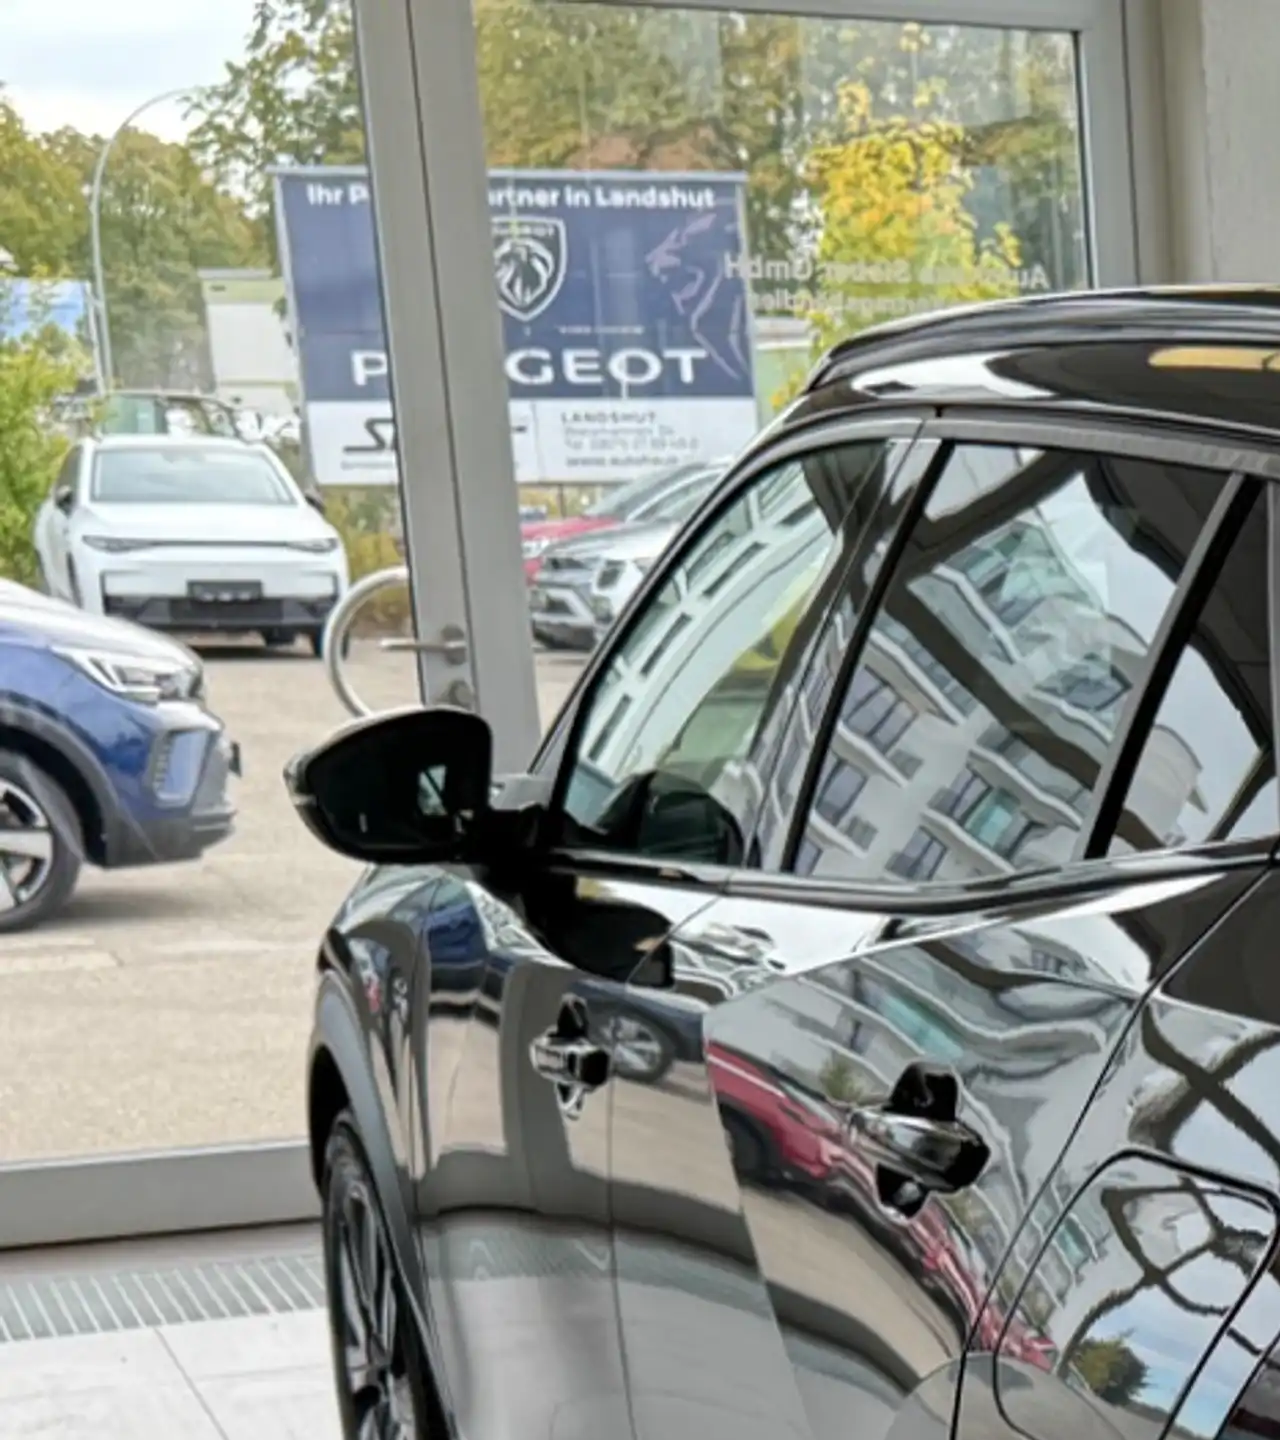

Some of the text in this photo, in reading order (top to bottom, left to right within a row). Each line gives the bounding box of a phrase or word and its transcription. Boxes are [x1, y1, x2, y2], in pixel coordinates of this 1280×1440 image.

[306, 183, 343, 206] Ihr
[564, 184, 591, 207] in
[595, 186, 715, 208] Landshut
[351, 348, 706, 386] PGEOT
